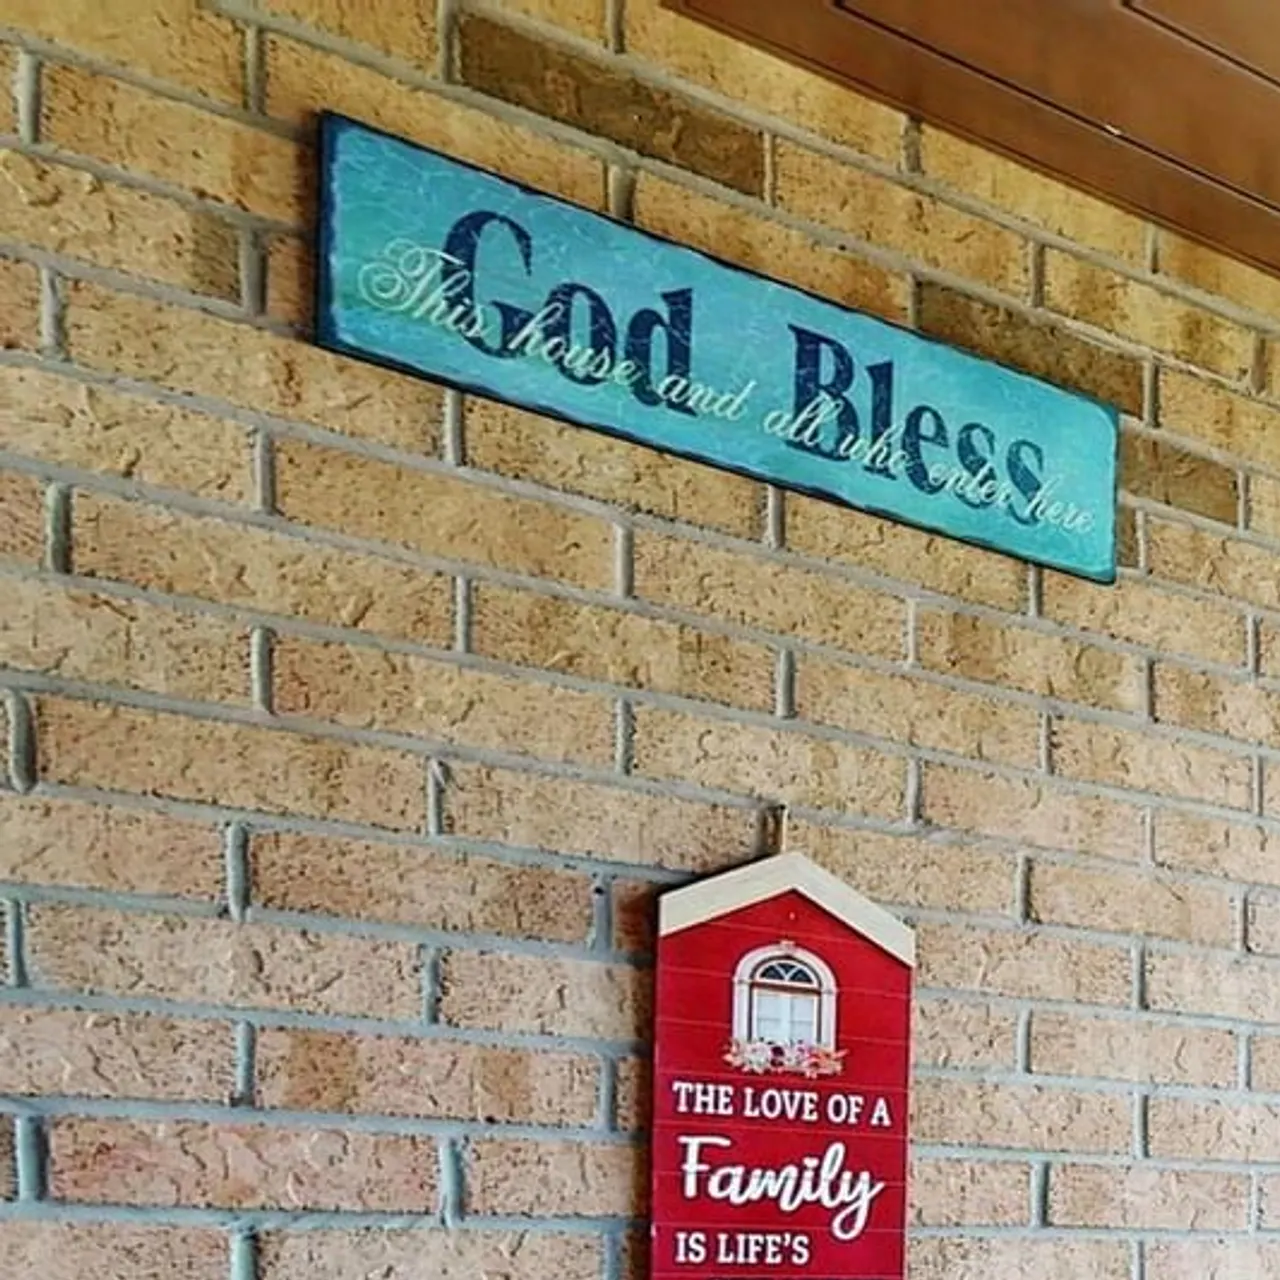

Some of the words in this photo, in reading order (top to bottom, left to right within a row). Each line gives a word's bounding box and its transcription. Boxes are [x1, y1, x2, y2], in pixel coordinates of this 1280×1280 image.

[358, 238, 494, 339] This
[508, 302, 643, 387] house
[657, 374, 756, 421] and
[762, 390, 844, 446] all
[840, 420, 914, 474] who
[929, 461, 1012, 511] enter
[1024, 476, 1094, 533] here
[440, 210, 698, 417] God
[787, 323, 1043, 525] Bless
[672, 1081, 734, 1115] THE
[743, 1087, 818, 1121] LOVE
[827, 1094, 864, 1125] OF
[871, 1097, 891, 1127] A
[677, 1135, 885, 1240] Family
[675, 1232, 706, 1263] IS
[716, 1233, 810, 1265] LIFE'S
